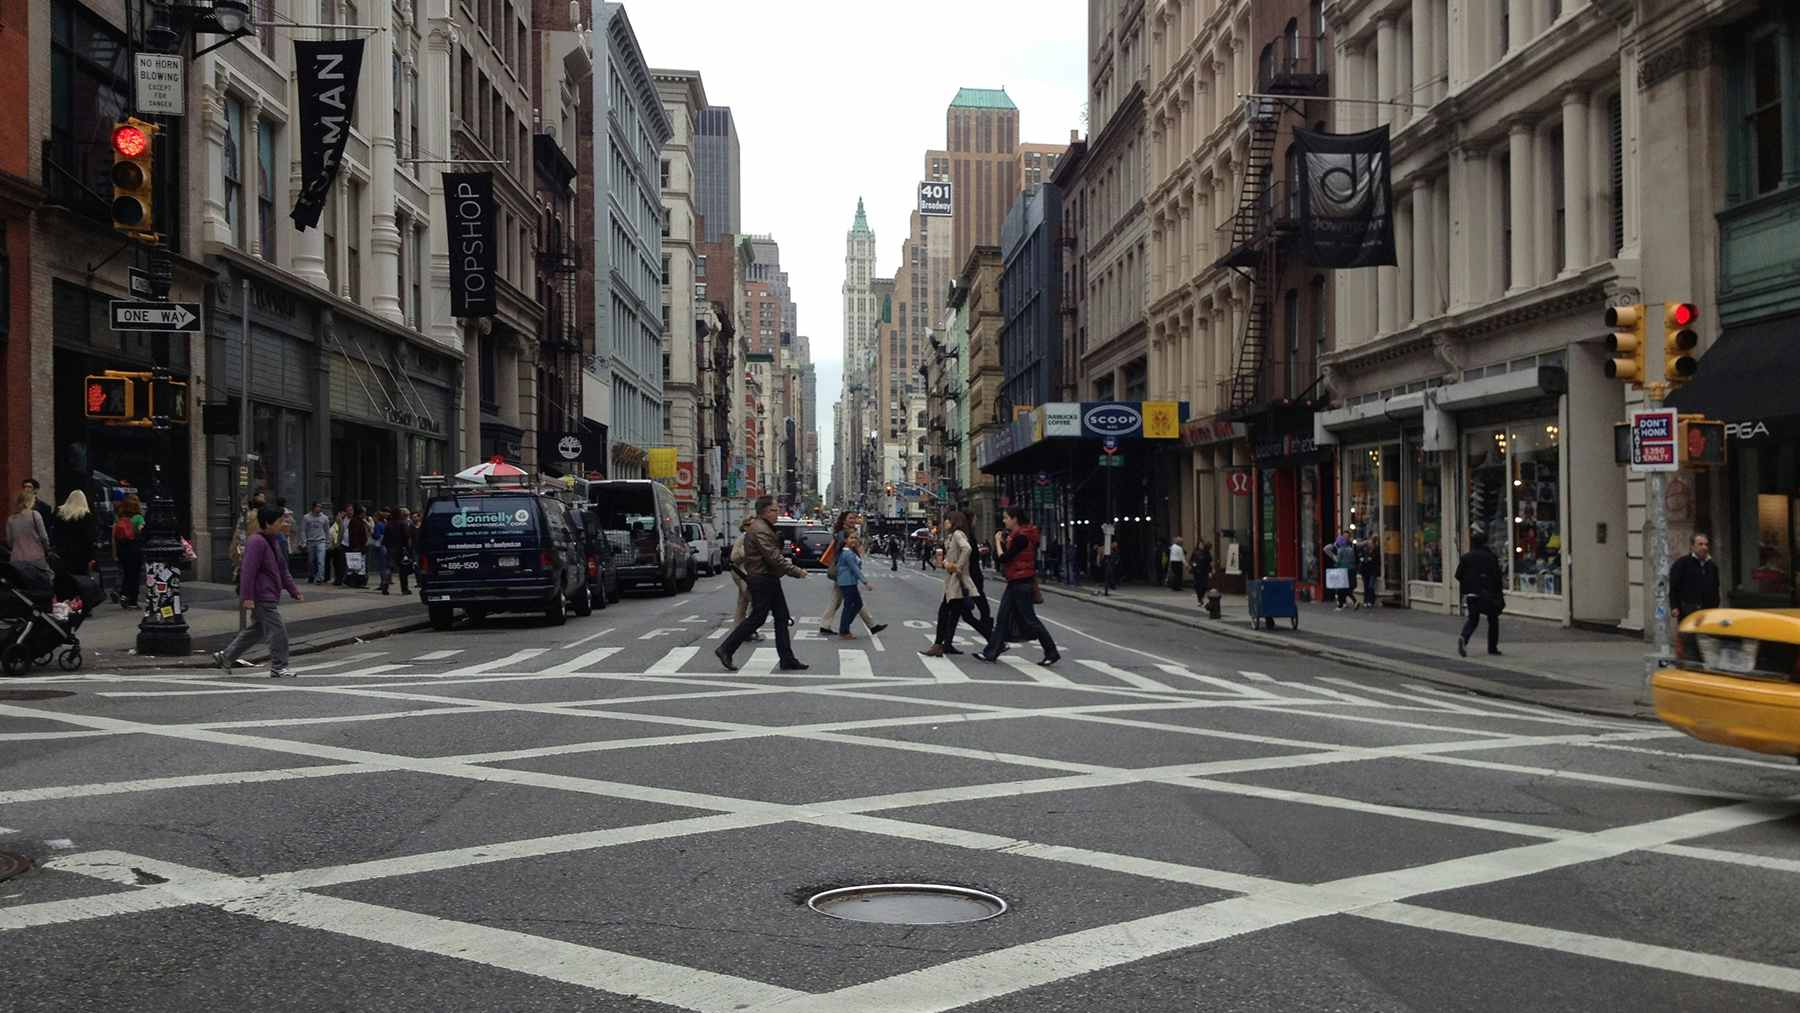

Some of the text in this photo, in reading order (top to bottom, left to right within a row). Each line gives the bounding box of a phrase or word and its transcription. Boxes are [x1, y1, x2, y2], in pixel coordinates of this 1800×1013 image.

[140, 59, 178, 69] NO HORN
[140, 71, 179, 82] BLOWING
[301, 54, 346, 206] OPMAN
[921, 185, 949, 198] 401
[920, 200, 951, 212] Broadway
[458, 183, 486, 309] TOPSHOP
[124, 310, 187, 323] ONE WAY
[1090, 416, 1137, 424] SCOOP
[1640, 418, 1667, 428] DON'T
[1640, 428, 1667, 437] HONK
[1641, 454, 1668, 462] ENALTY
[451, 508, 512, 528] donnelly
